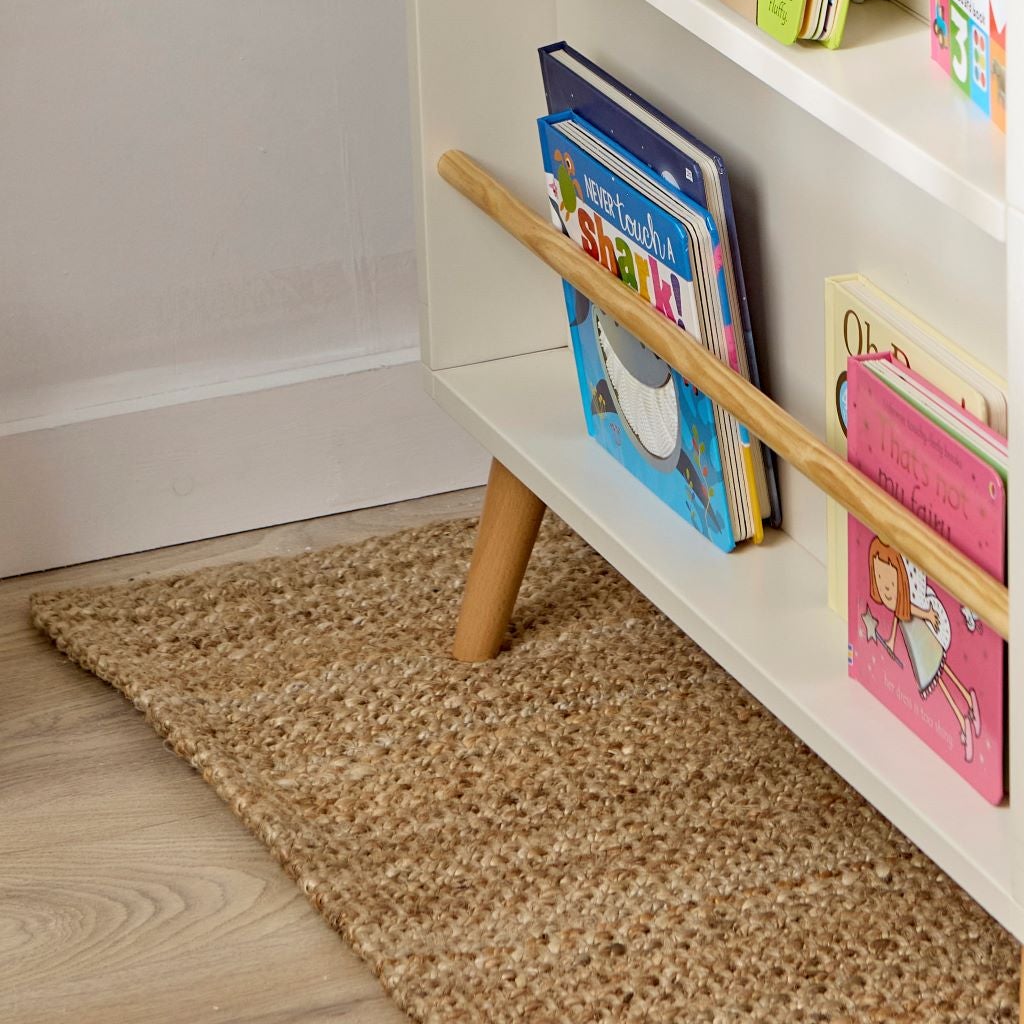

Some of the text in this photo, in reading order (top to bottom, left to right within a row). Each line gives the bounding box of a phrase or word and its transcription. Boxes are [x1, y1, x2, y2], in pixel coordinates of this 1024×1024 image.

[951, 4, 968, 84] 3
[583, 173, 676, 264] NEVER touch A
